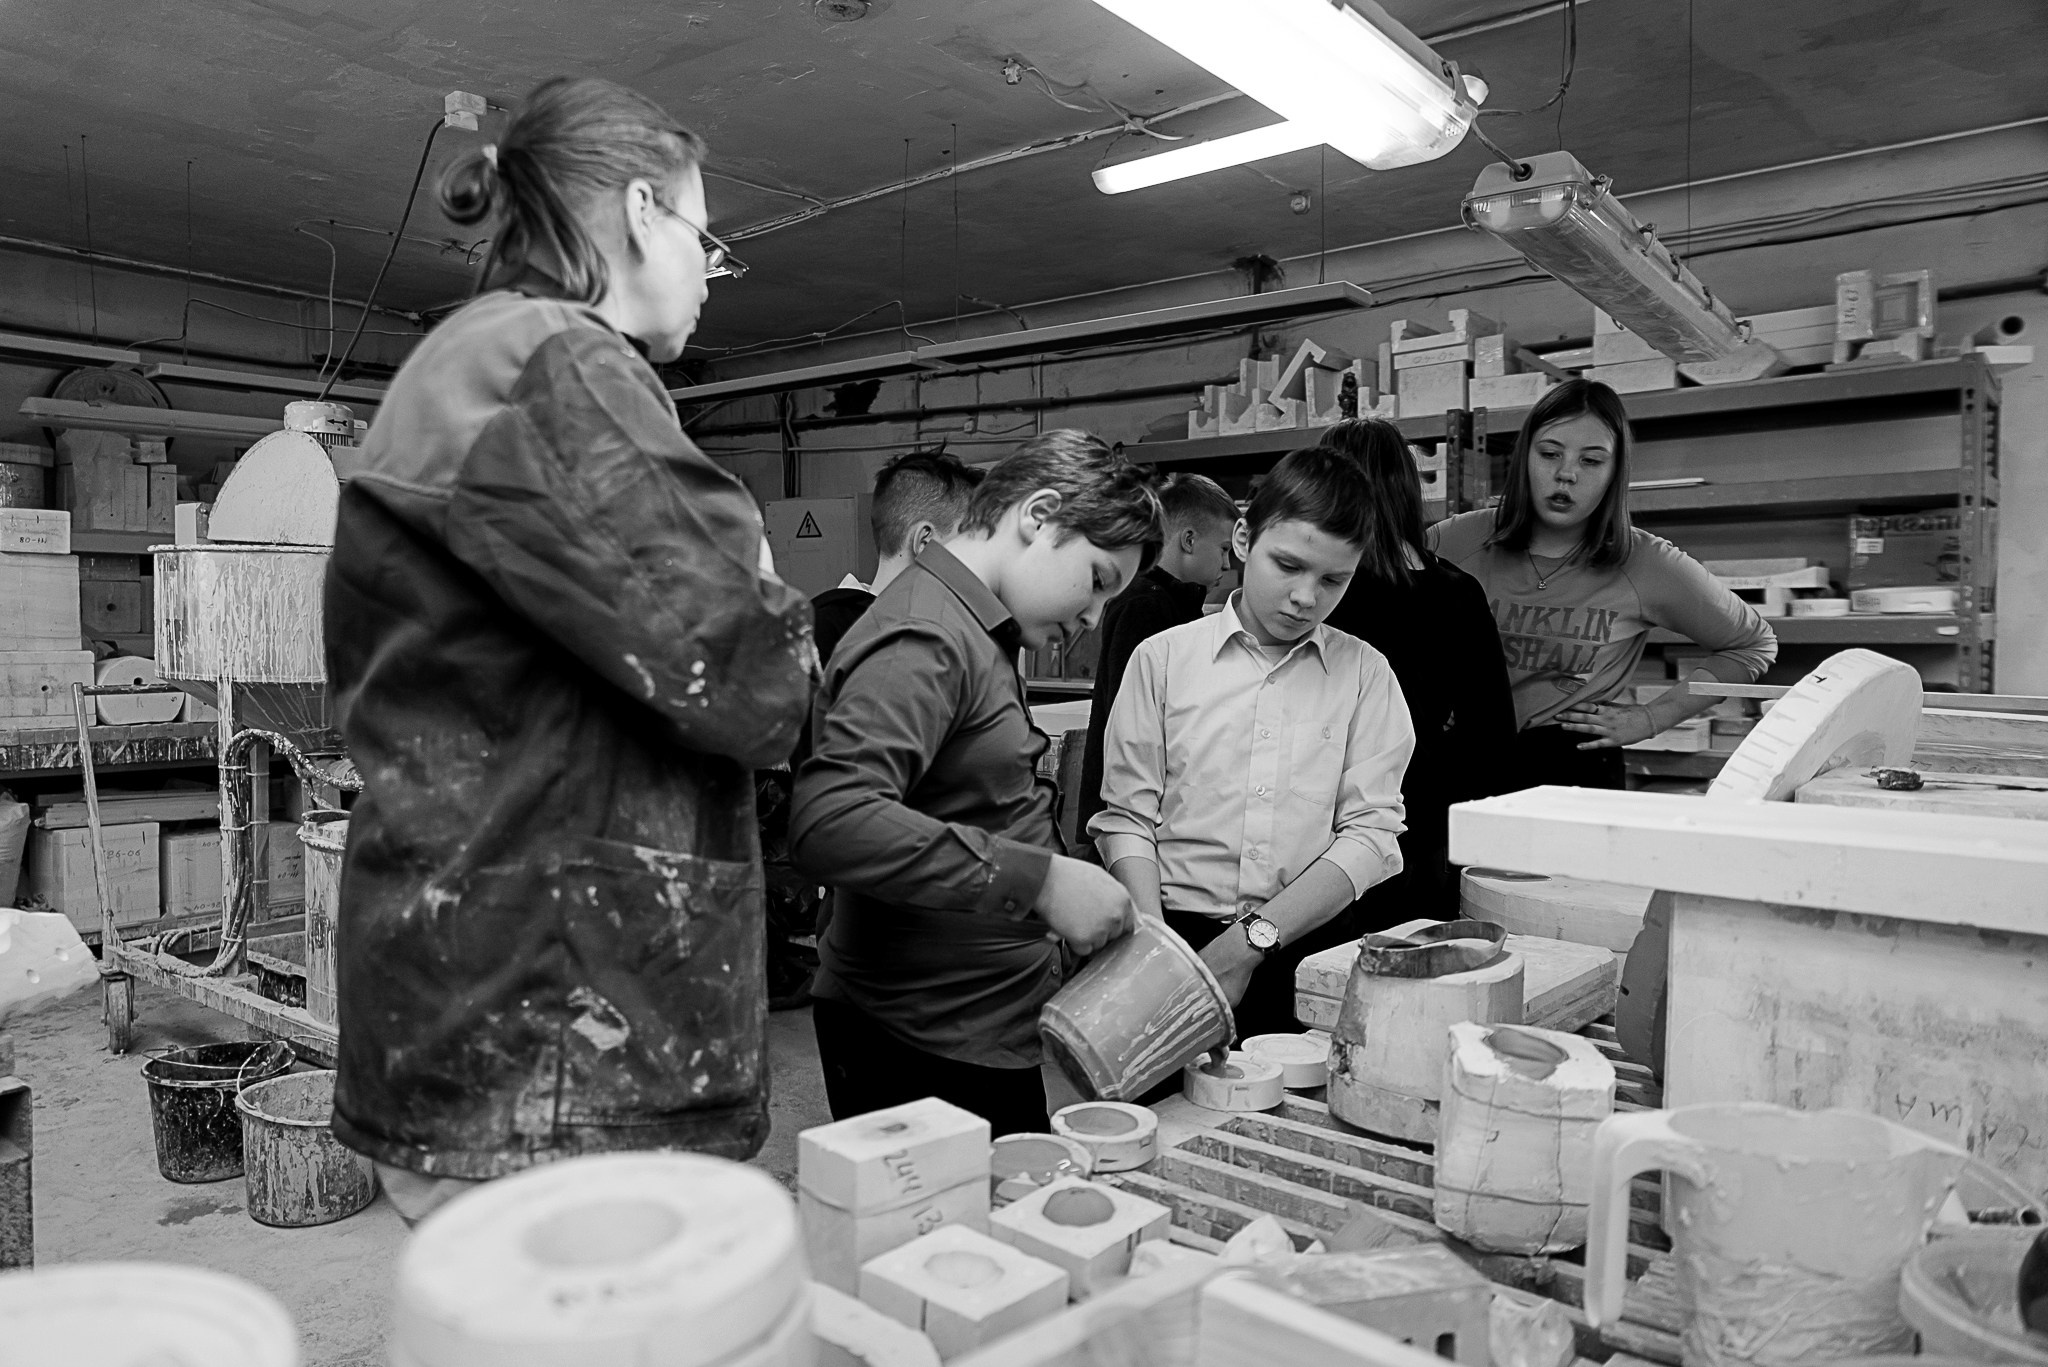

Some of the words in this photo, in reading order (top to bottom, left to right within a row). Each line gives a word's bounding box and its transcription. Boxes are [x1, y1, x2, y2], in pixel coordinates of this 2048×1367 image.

[1490, 598, 1619, 643] NKLIN
[1503, 637, 1601, 675] SHALL
[882, 1148, 923, 1195] 244
